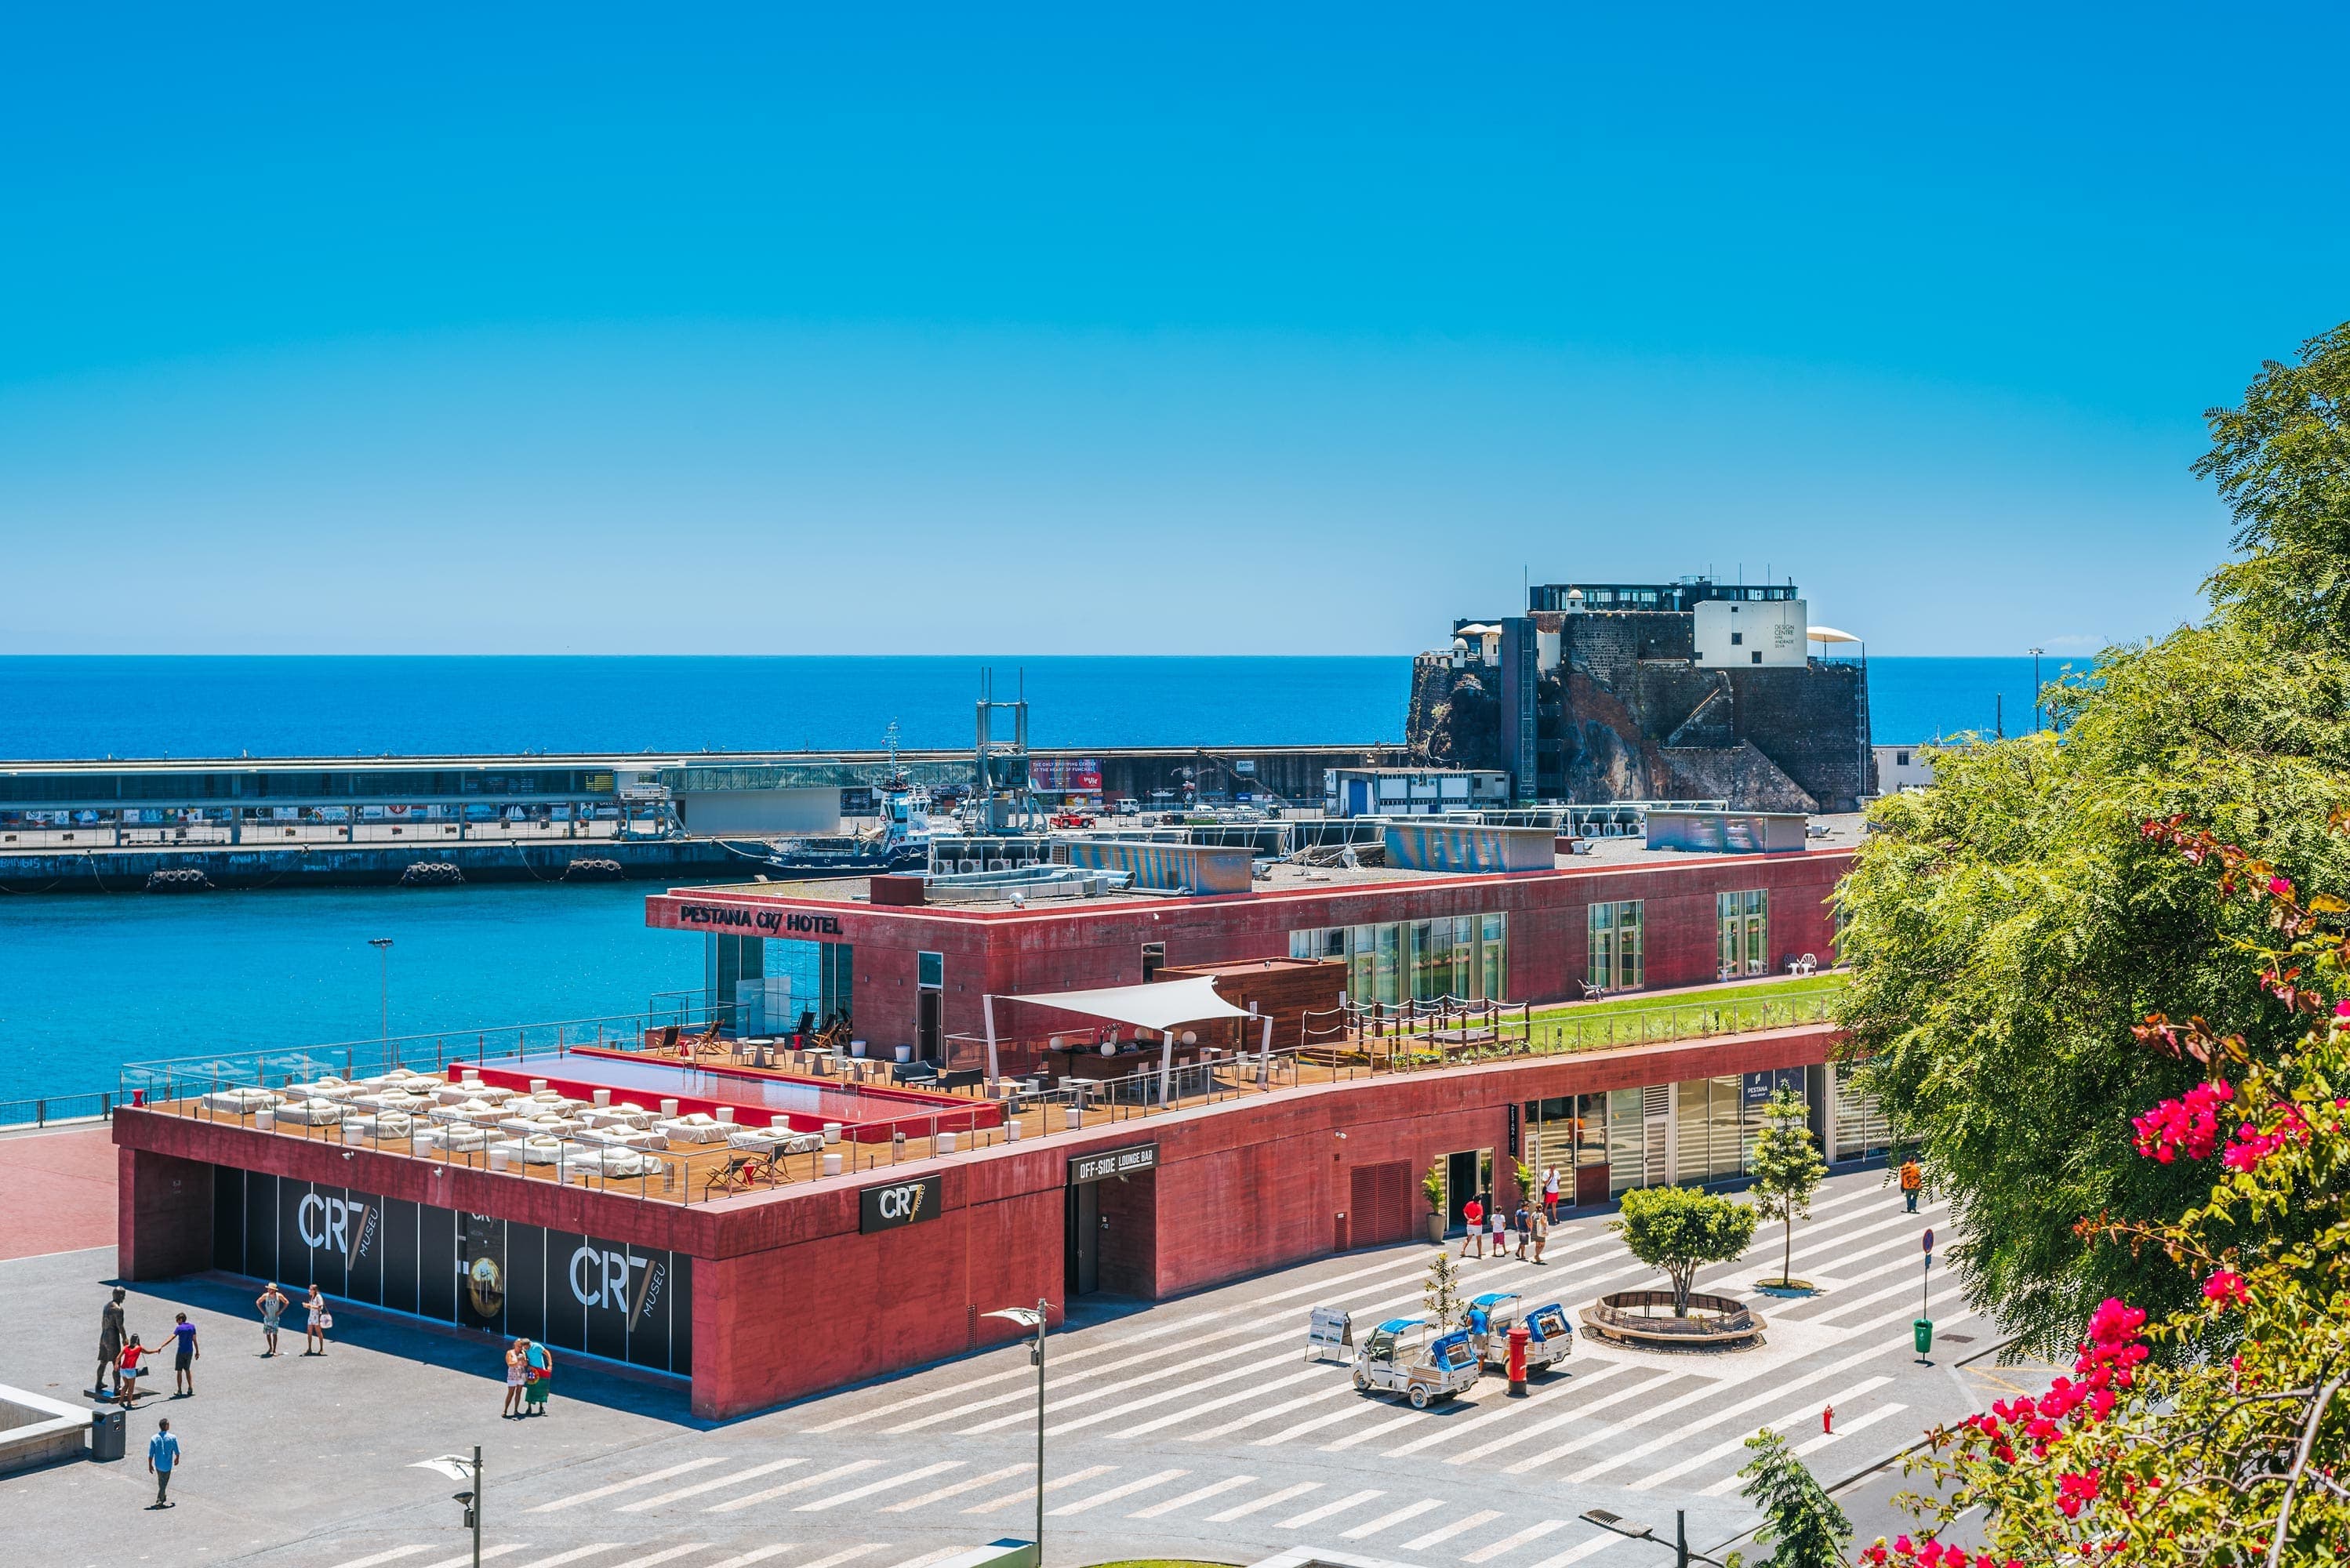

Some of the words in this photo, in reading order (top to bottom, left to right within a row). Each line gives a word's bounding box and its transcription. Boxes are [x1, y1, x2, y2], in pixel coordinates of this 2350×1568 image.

[681, 904, 752, 927] PESTANA
[755, 911, 783, 935] CR7
[786, 913, 843, 935] HOTEL
[1747, 1085, 1768, 1094] PESTANA
[1080, 1157, 1116, 1178] OFF-SIDE
[1118, 1152, 1140, 1167] LOUNGE
[1141, 1149, 1153, 1162] BAR
[879, 1184, 923, 1222] CR7
[299, 1193, 370, 1271] CR7
[360, 1207, 379, 1257] MUSEU
[569, 1247, 656, 1333] CR7
[643, 1263, 666, 1317] MUSEU
